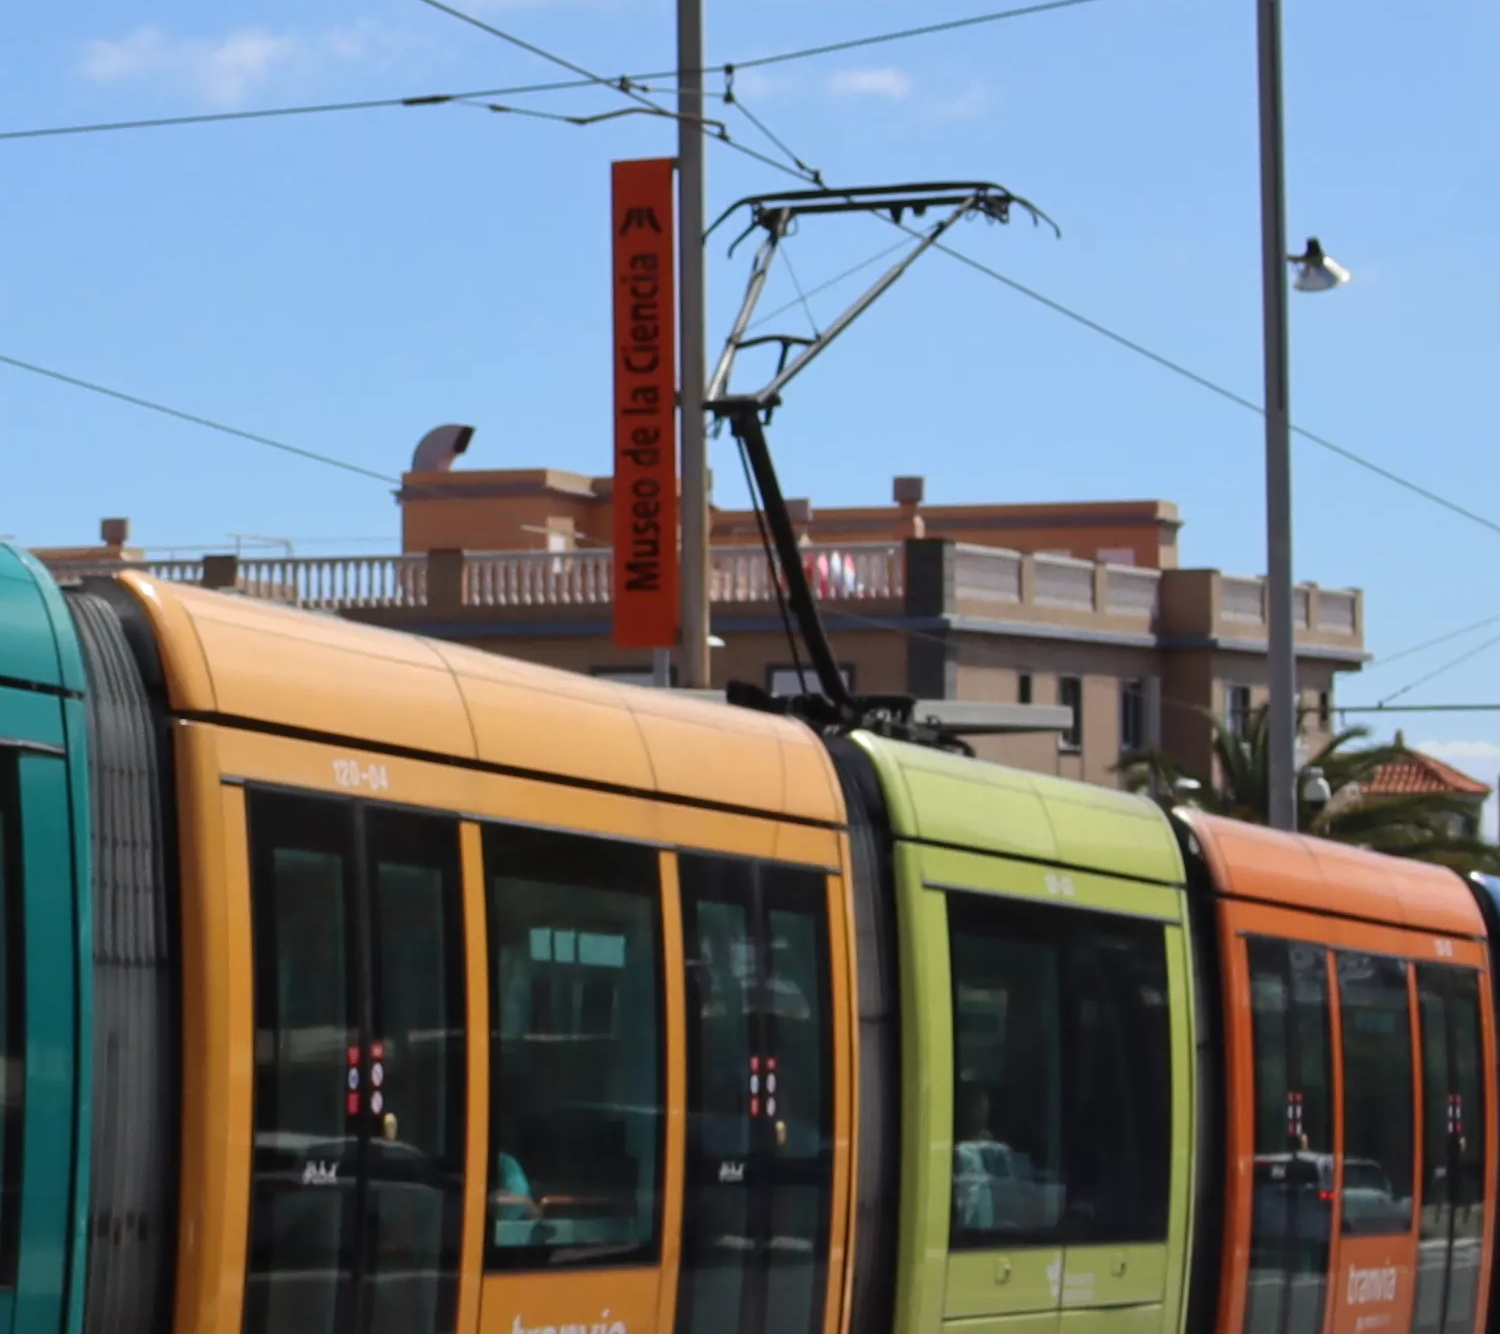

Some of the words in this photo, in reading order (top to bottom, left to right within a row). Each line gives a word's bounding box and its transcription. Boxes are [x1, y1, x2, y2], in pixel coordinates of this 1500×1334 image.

[620, 253, 660, 374] Ciencia
[621, 386, 660, 414] la
[622, 427, 661, 466] de
[625, 478, 661, 591] Museo
